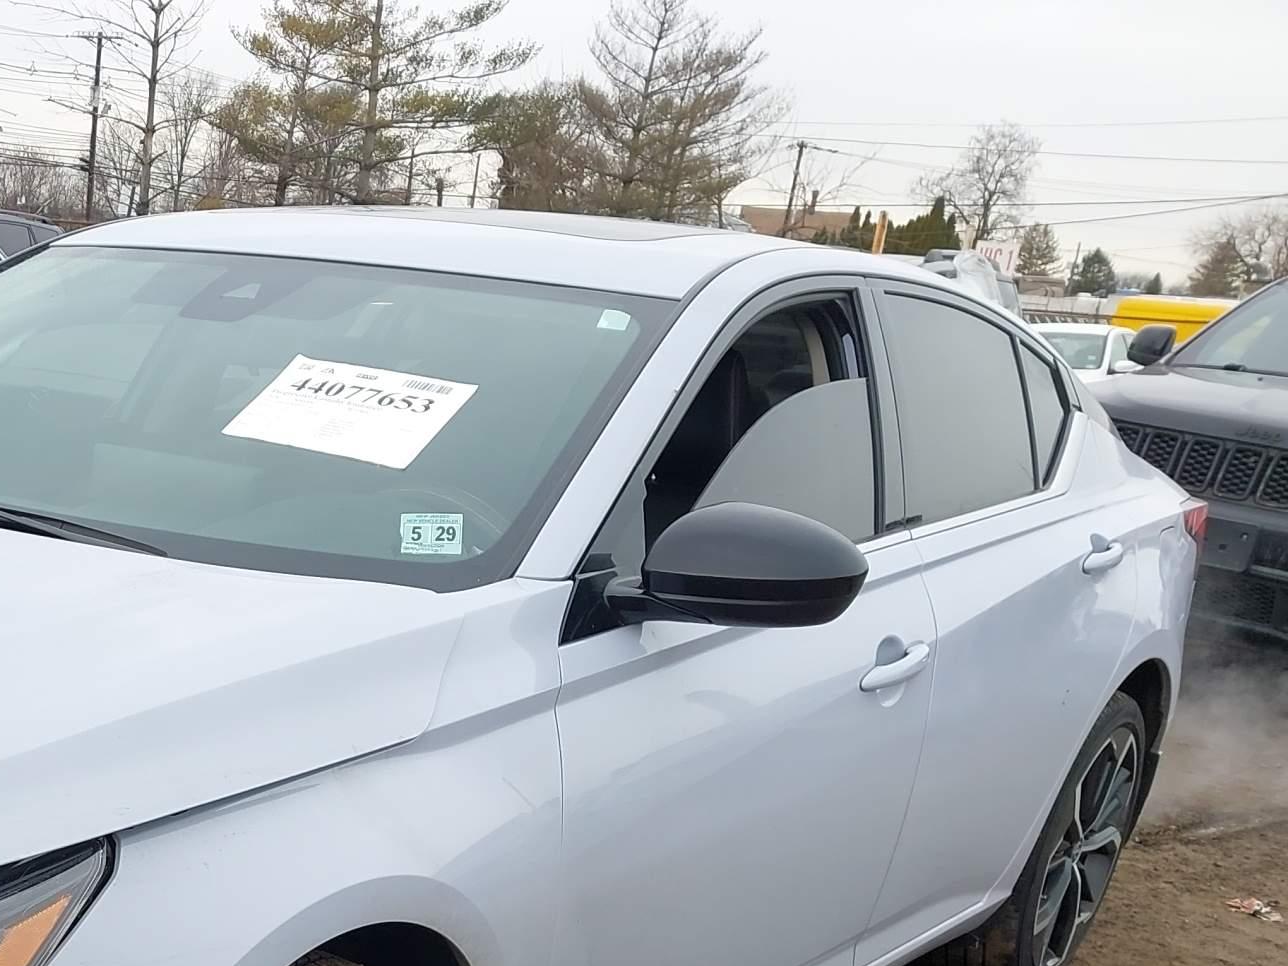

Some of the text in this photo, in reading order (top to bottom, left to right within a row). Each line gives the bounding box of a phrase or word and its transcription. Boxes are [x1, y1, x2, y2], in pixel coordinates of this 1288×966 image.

[290, 378, 435, 413] 44077653
[411, 526, 456, 541] 5 29
